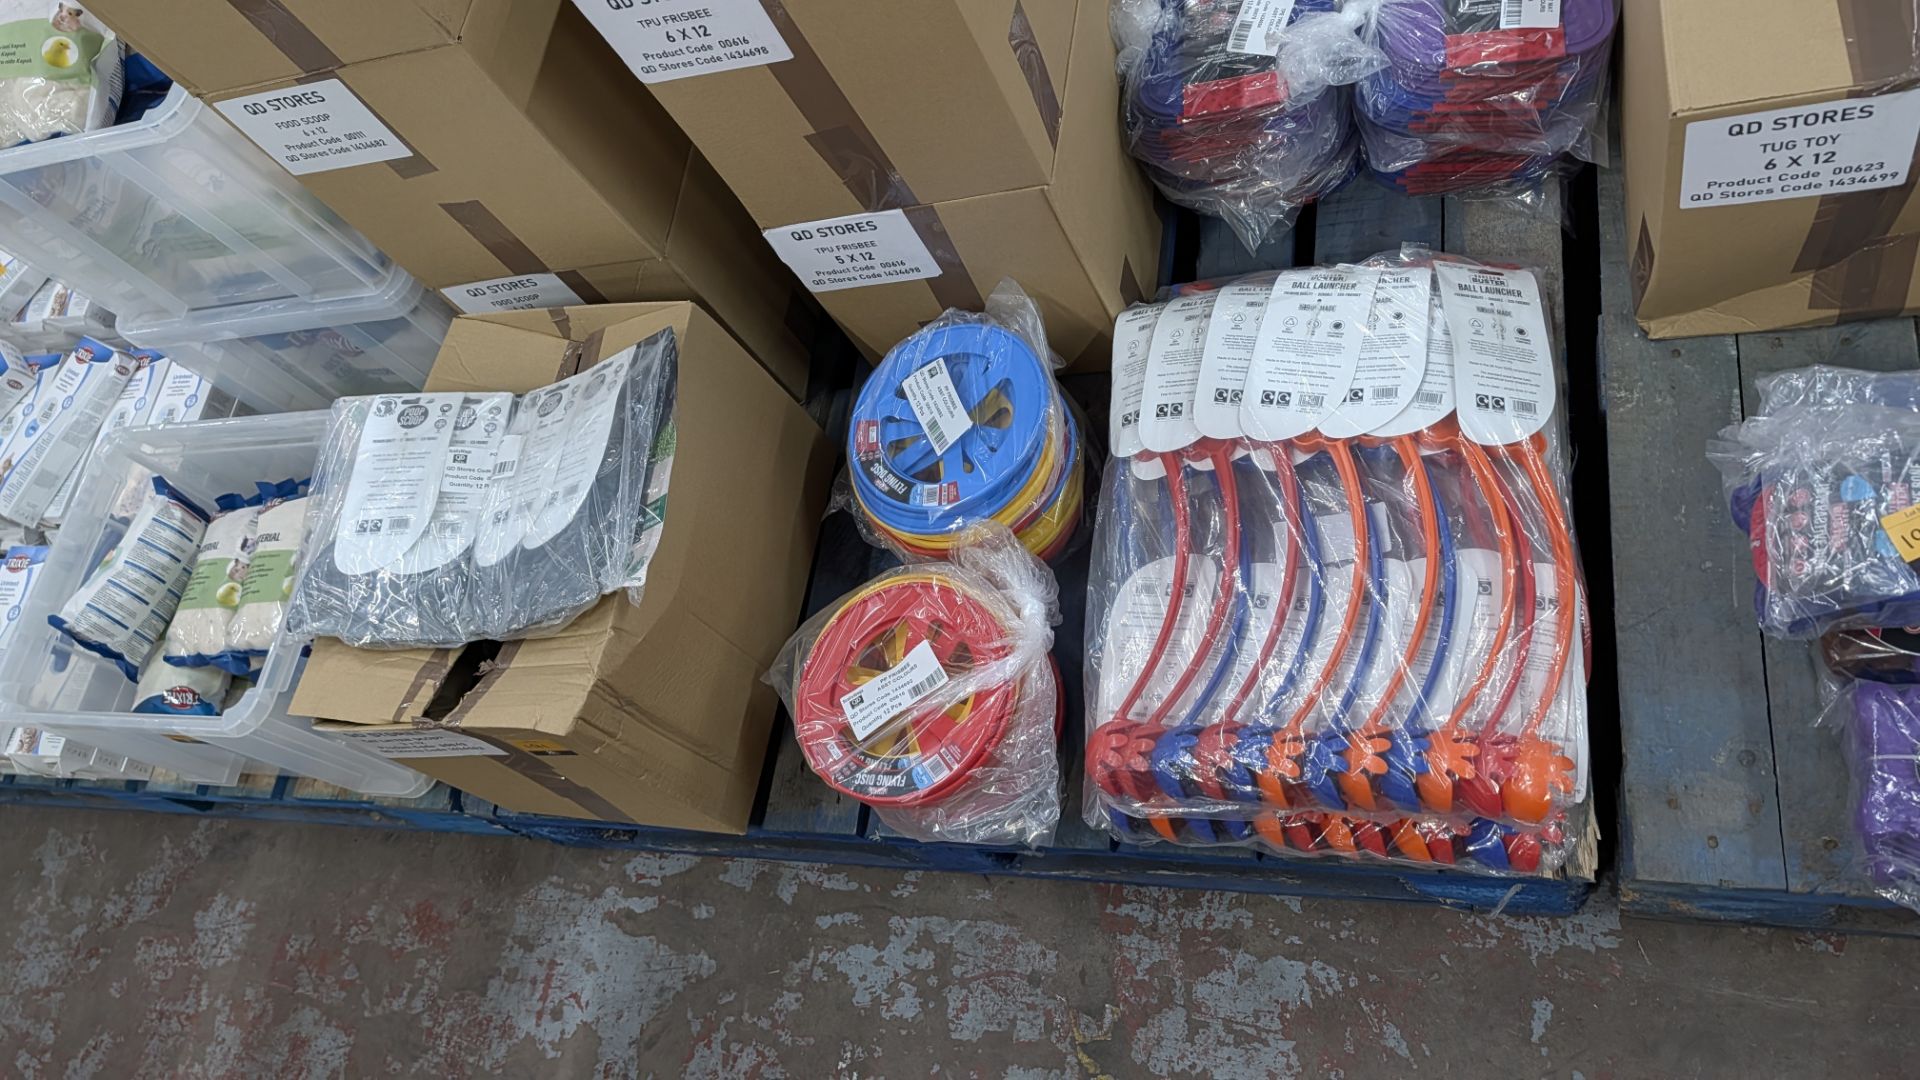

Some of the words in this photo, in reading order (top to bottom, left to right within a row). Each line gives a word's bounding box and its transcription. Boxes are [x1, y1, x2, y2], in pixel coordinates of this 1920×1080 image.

[637, 18, 661, 29] TPU
[662, 8, 712, 24] FRISBEE
[665, 32, 676, 42] 6
[692, 25, 712, 38] 12
[643, 48, 685, 61] Product
[685, 44, 713, 54] Code
[718, 36, 749, 49] 00616
[641, 65, 657, 74] QD
[659, 60, 694, 72] Stores
[695, 54, 723, 66] Code
[724, 46, 769, 60] 1434698
[243, 102, 267, 115] QD
[267, 91, 325, 111] STORES
[275, 119, 300, 130] FOOD
[300, 113, 330, 125] SCOOP
[1728, 121, 1762, 137] QD
[1771, 104, 1875, 131] STORES
[285, 140, 318, 151] Product
[319, 136, 342, 147] Code
[344, 131, 366, 141] 00111
[1760, 140, 1798, 154] TUG
[1804, 134, 1841, 148] TOY
[285, 154, 300, 162] QD
[300, 150, 329, 160] Stores
[329, 145, 351, 156] Code
[1764, 158, 1777, 171] 6
[1813, 151, 1837, 165] 12
[1707, 176, 1772, 189] Product
[1778, 170, 1820, 182] Code
[1833, 162, 1885, 176] 00623
[1690, 192, 1713, 202] QD
[1719, 187, 1774, 200] Stores
[1781, 181, 1822, 193] Code
[1829, 171, 1899, 188] 1434699
[791, 230, 813, 241] QD
[817, 221, 878, 238] STORES
[814, 247, 834, 255] TPU
[836, 240, 878, 252] FRISBEE
[835, 255, 845, 265] 5
[859, 251, 875, 261] 12
[815, 266, 851, 277] Product
[853, 264, 875, 272] Code
[880, 260, 906, 269] 00616
[828, 274, 858, 284] Stores
[859, 271, 883, 280] Code
[1472, 277, 1506, 286] BUSTER
[466, 288, 486, 297] QD
[487, 279, 538, 294] STORES
[1458, 283, 1478, 292] BALL
[1480, 286, 1522, 298] LAUNCHER
[490, 298, 513, 307] FOOD
[514, 294, 540, 303] SCOOP
[403, 406, 426, 416] POOP
[399, 416, 425, 426] SCOOP
[870, 462, 886, 480] DISC
[886, 473, 908, 494] FLYING
[852, 711, 874, 726] Product
[861, 714, 884, 731] Quantity
[890, 702, 902, 711] Pcs
[855, 773, 875, 785] DISC
[877, 774, 906, 786] FLYING
